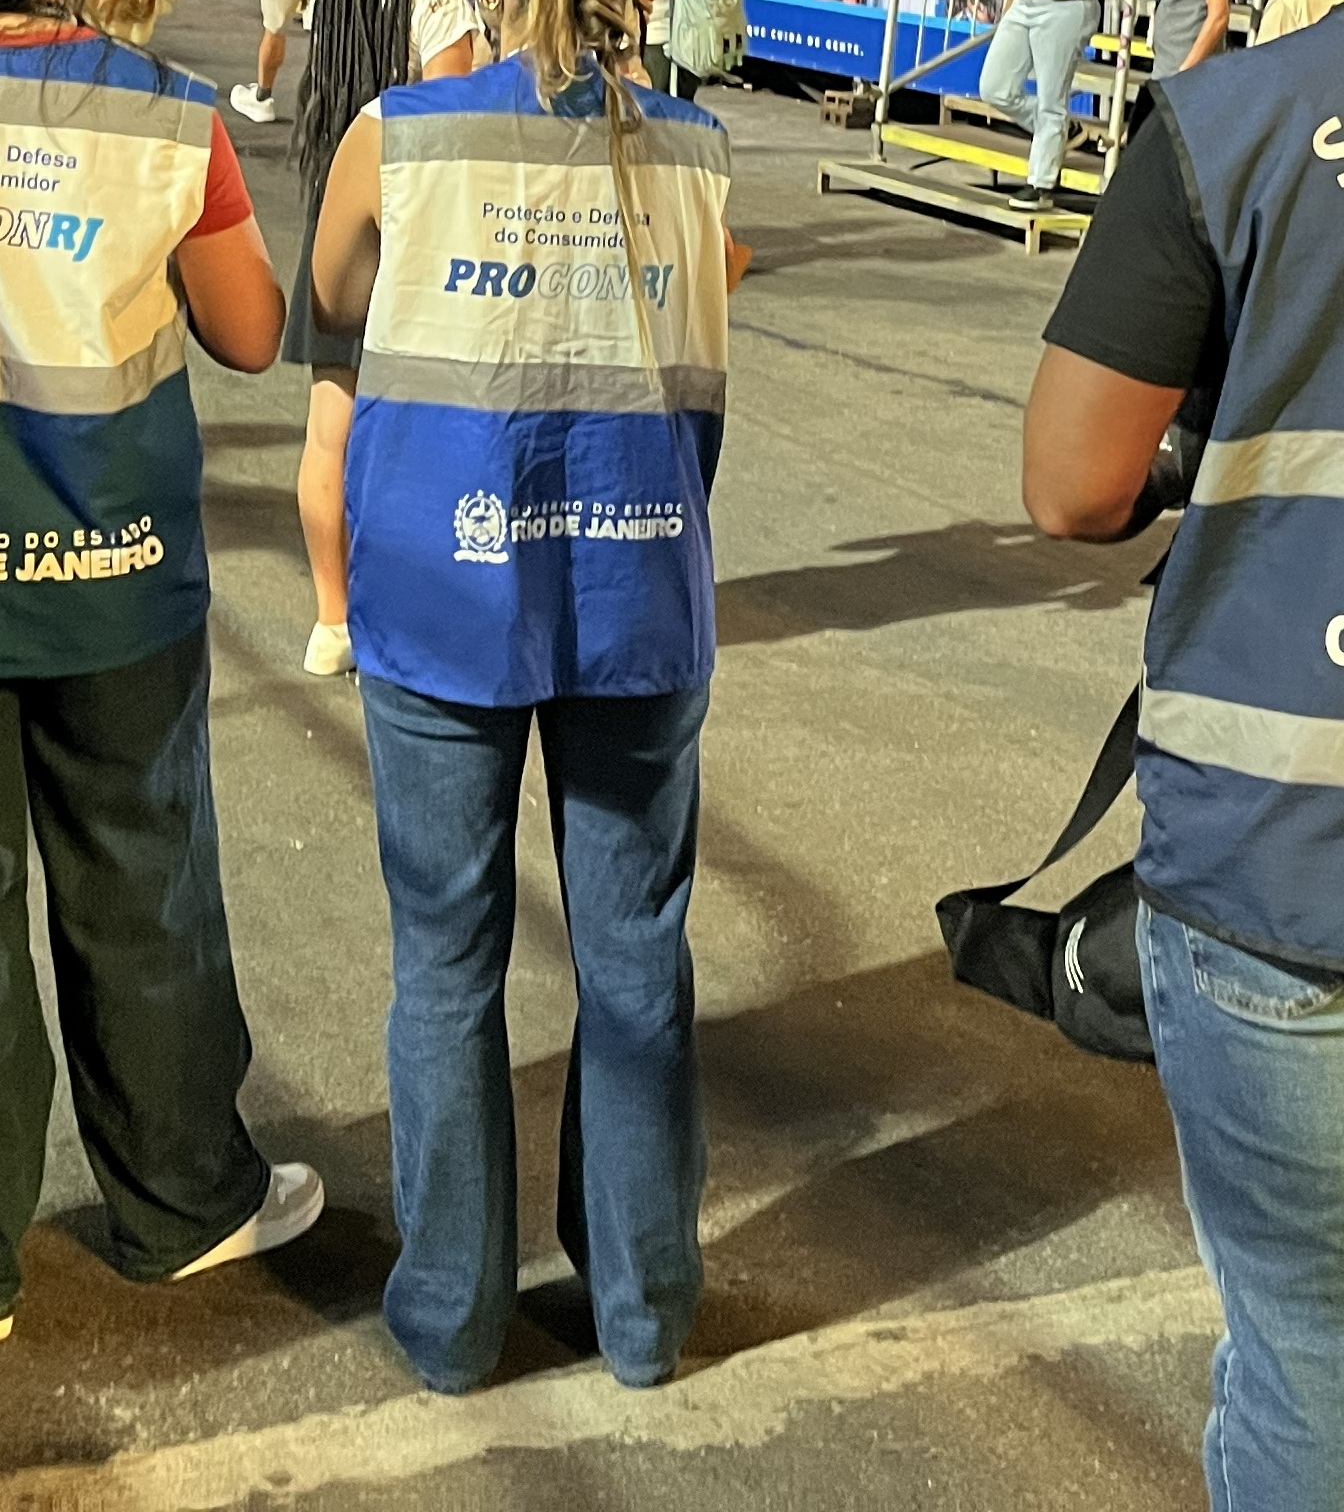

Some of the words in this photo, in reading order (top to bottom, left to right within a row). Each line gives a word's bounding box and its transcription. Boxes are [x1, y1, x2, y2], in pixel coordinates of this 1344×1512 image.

[770, 28, 803, 45] CUIDA
[6, 144, 78, 170] Defesa
[482, 202, 566, 226] Proteção
[572, 210, 582, 224] e
[494, 227, 519, 244] do
[592, 502, 616, 517] DO
[510, 516, 547, 543] RIO
[549, 514, 581, 538] DE
[585, 516, 684, 541] JANEIRO
[25, 531, 59, 550] DO
[15, 535, 164, 582] JANEIRO
